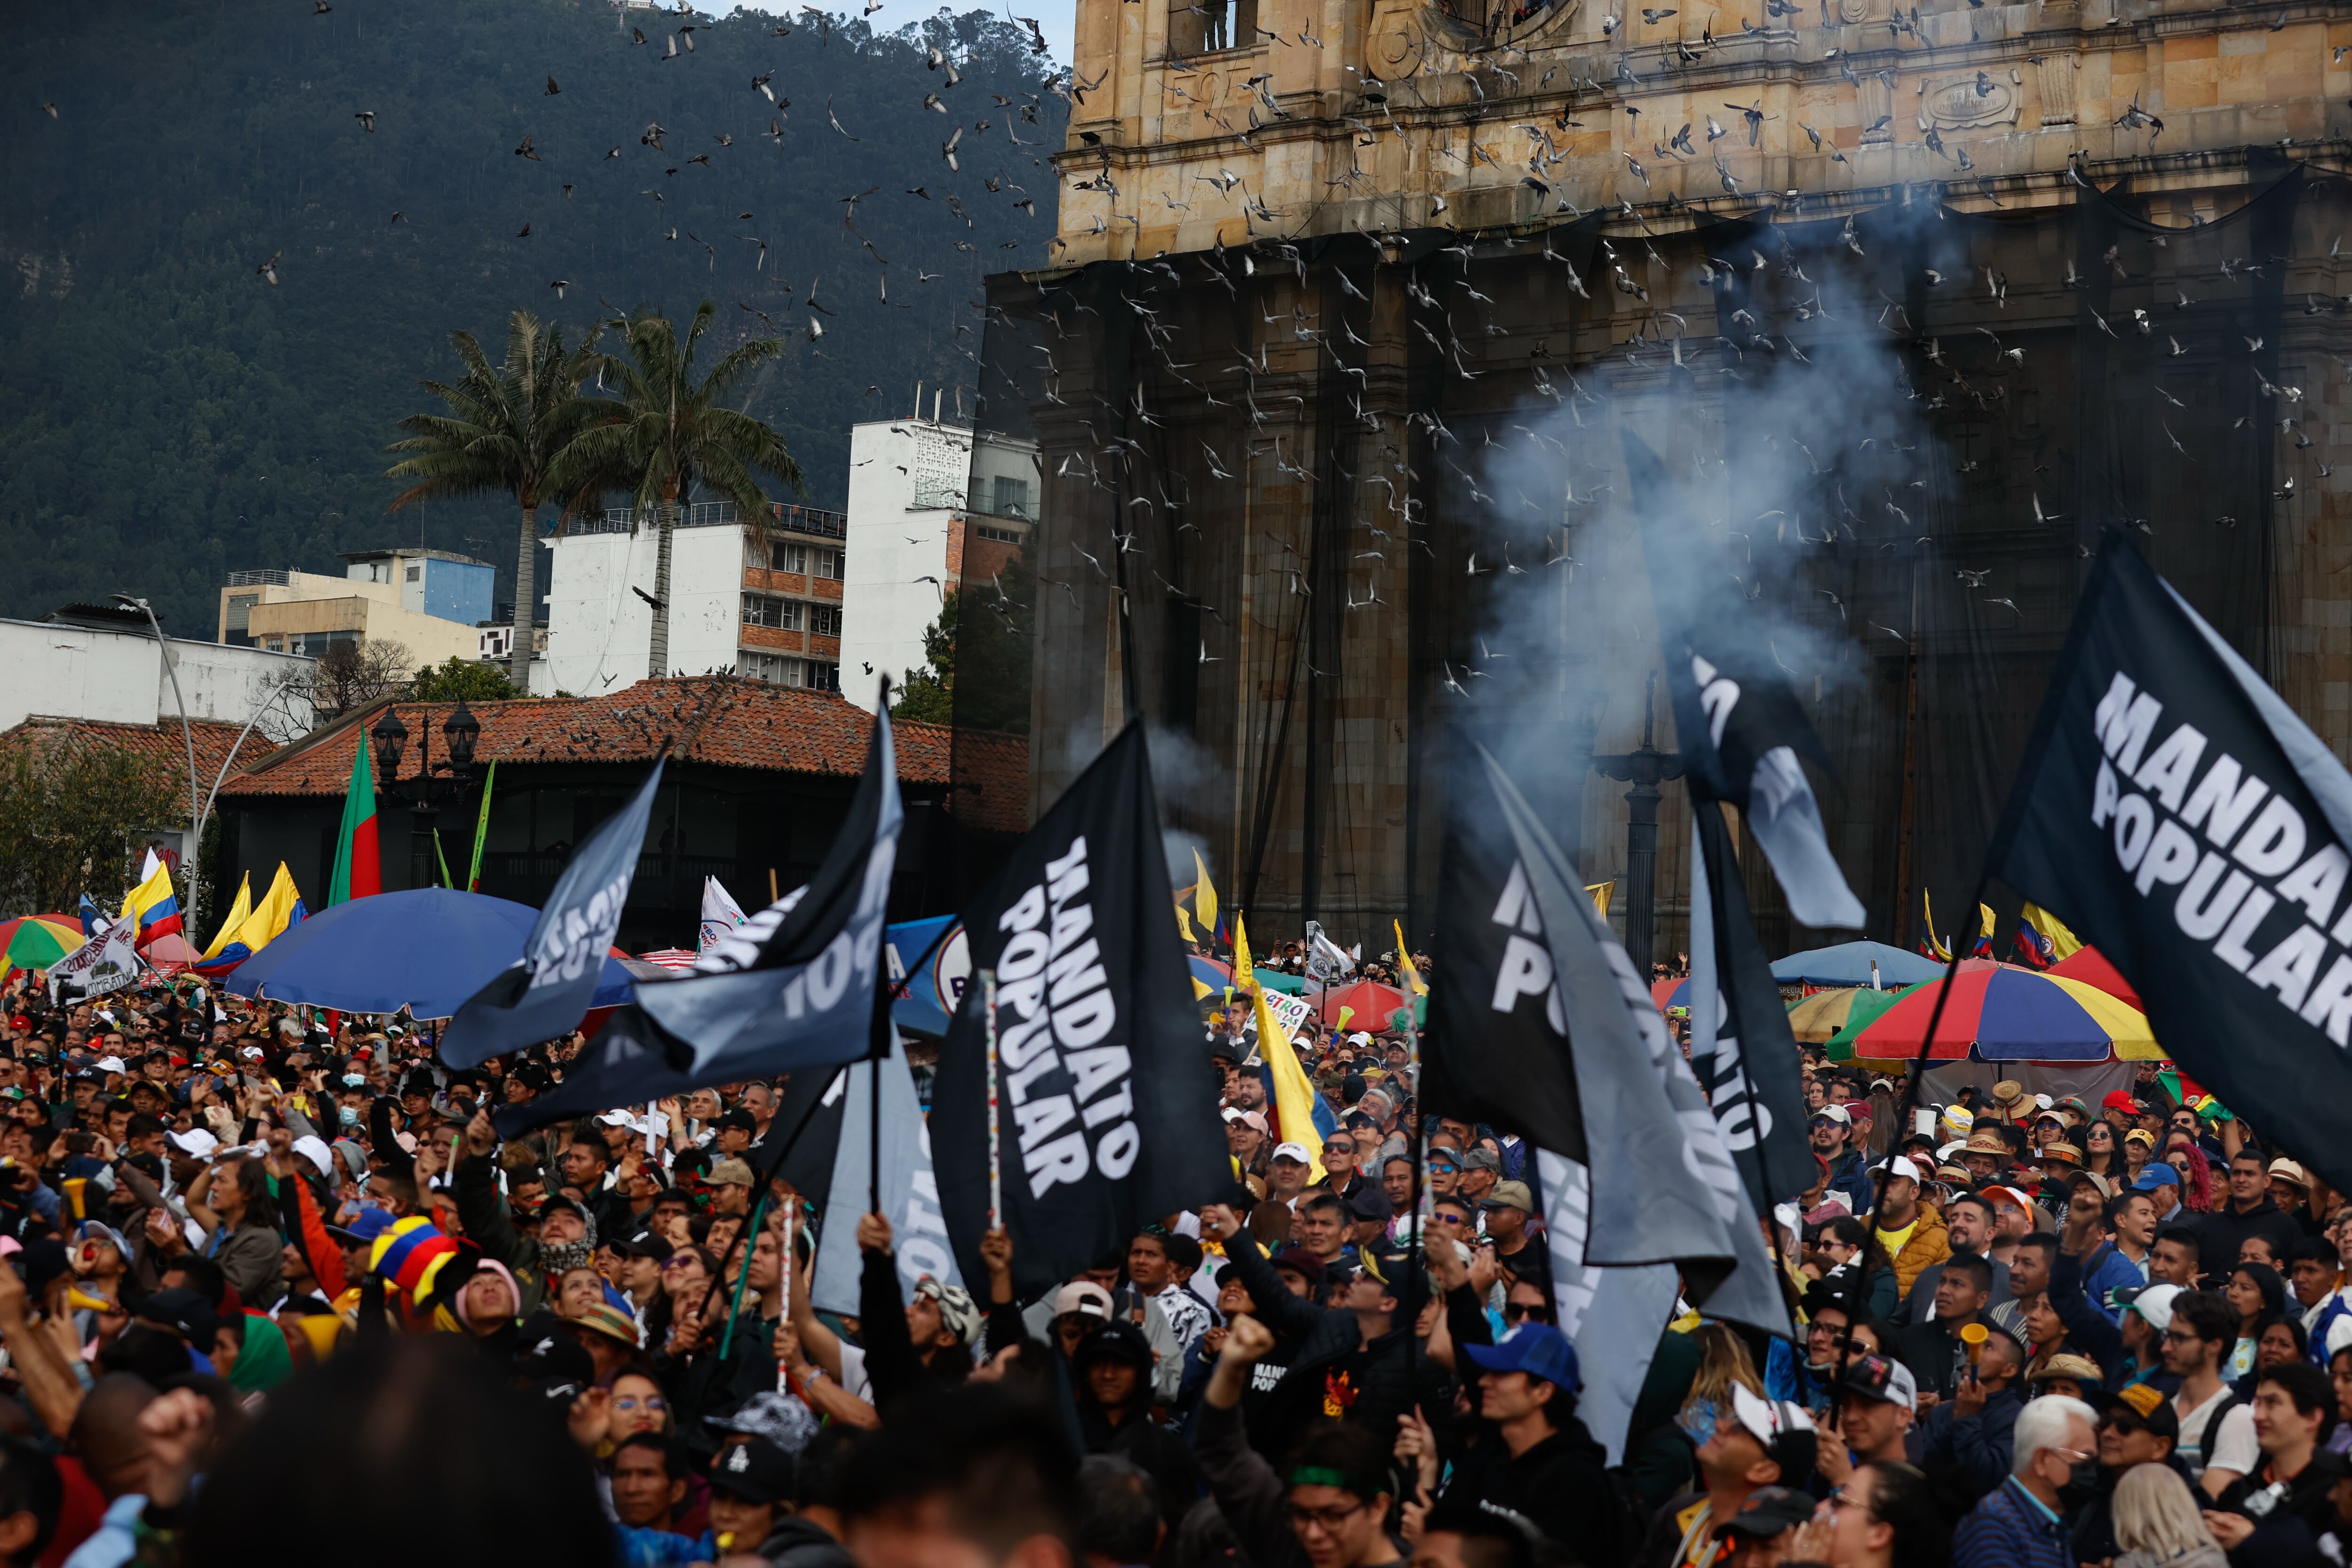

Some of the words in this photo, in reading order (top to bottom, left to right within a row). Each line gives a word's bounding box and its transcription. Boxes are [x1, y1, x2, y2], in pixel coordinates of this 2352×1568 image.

[2091, 756, 2352, 1050] POPULAR
[2094, 670, 2352, 947] MANDA
[996, 884, 1090, 1200] POPULAR
[1045, 836, 1140, 1180] MANDATO
